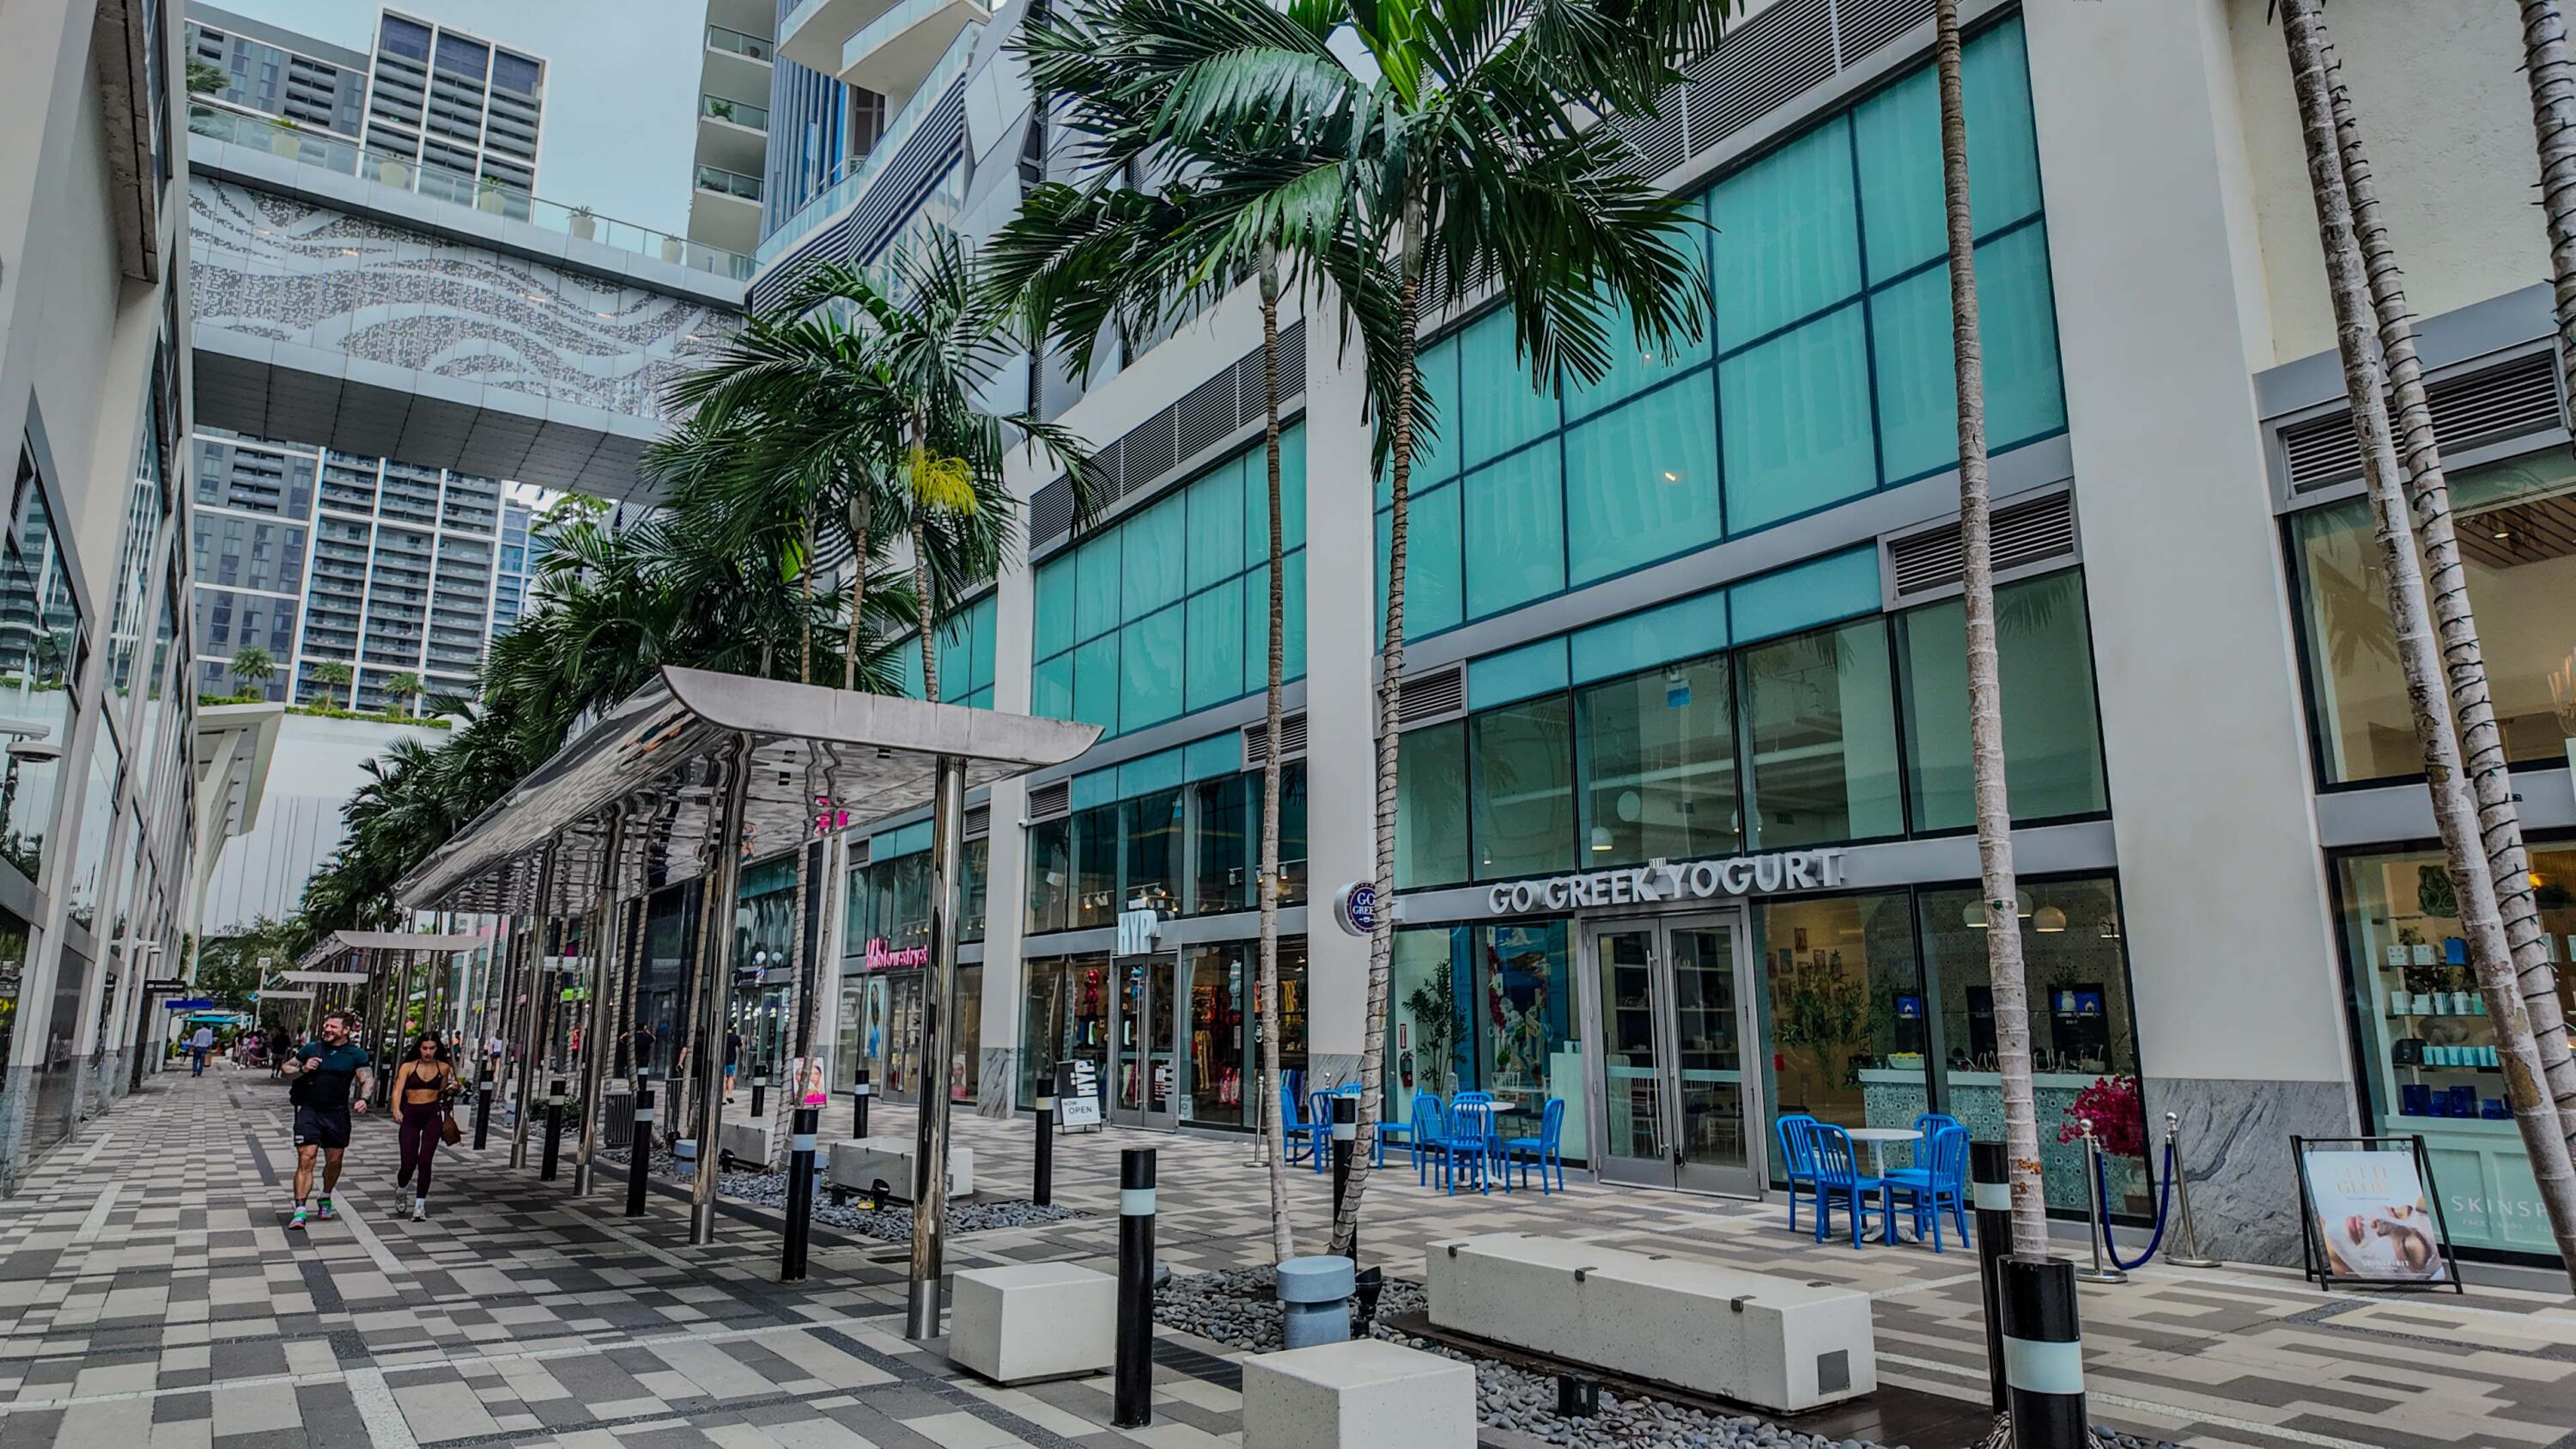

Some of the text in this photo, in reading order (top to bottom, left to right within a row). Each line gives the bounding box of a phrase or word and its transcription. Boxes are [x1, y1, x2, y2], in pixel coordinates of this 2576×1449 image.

[1489, 848, 1844, 915] GO GREEK YOGURT
[1357, 892, 1376, 906] GO
[1352, 905, 1376, 915] GREE
[1068, 1105, 1092, 1114] OPEN
[2451, 1195, 2548, 1218] SKINSP
